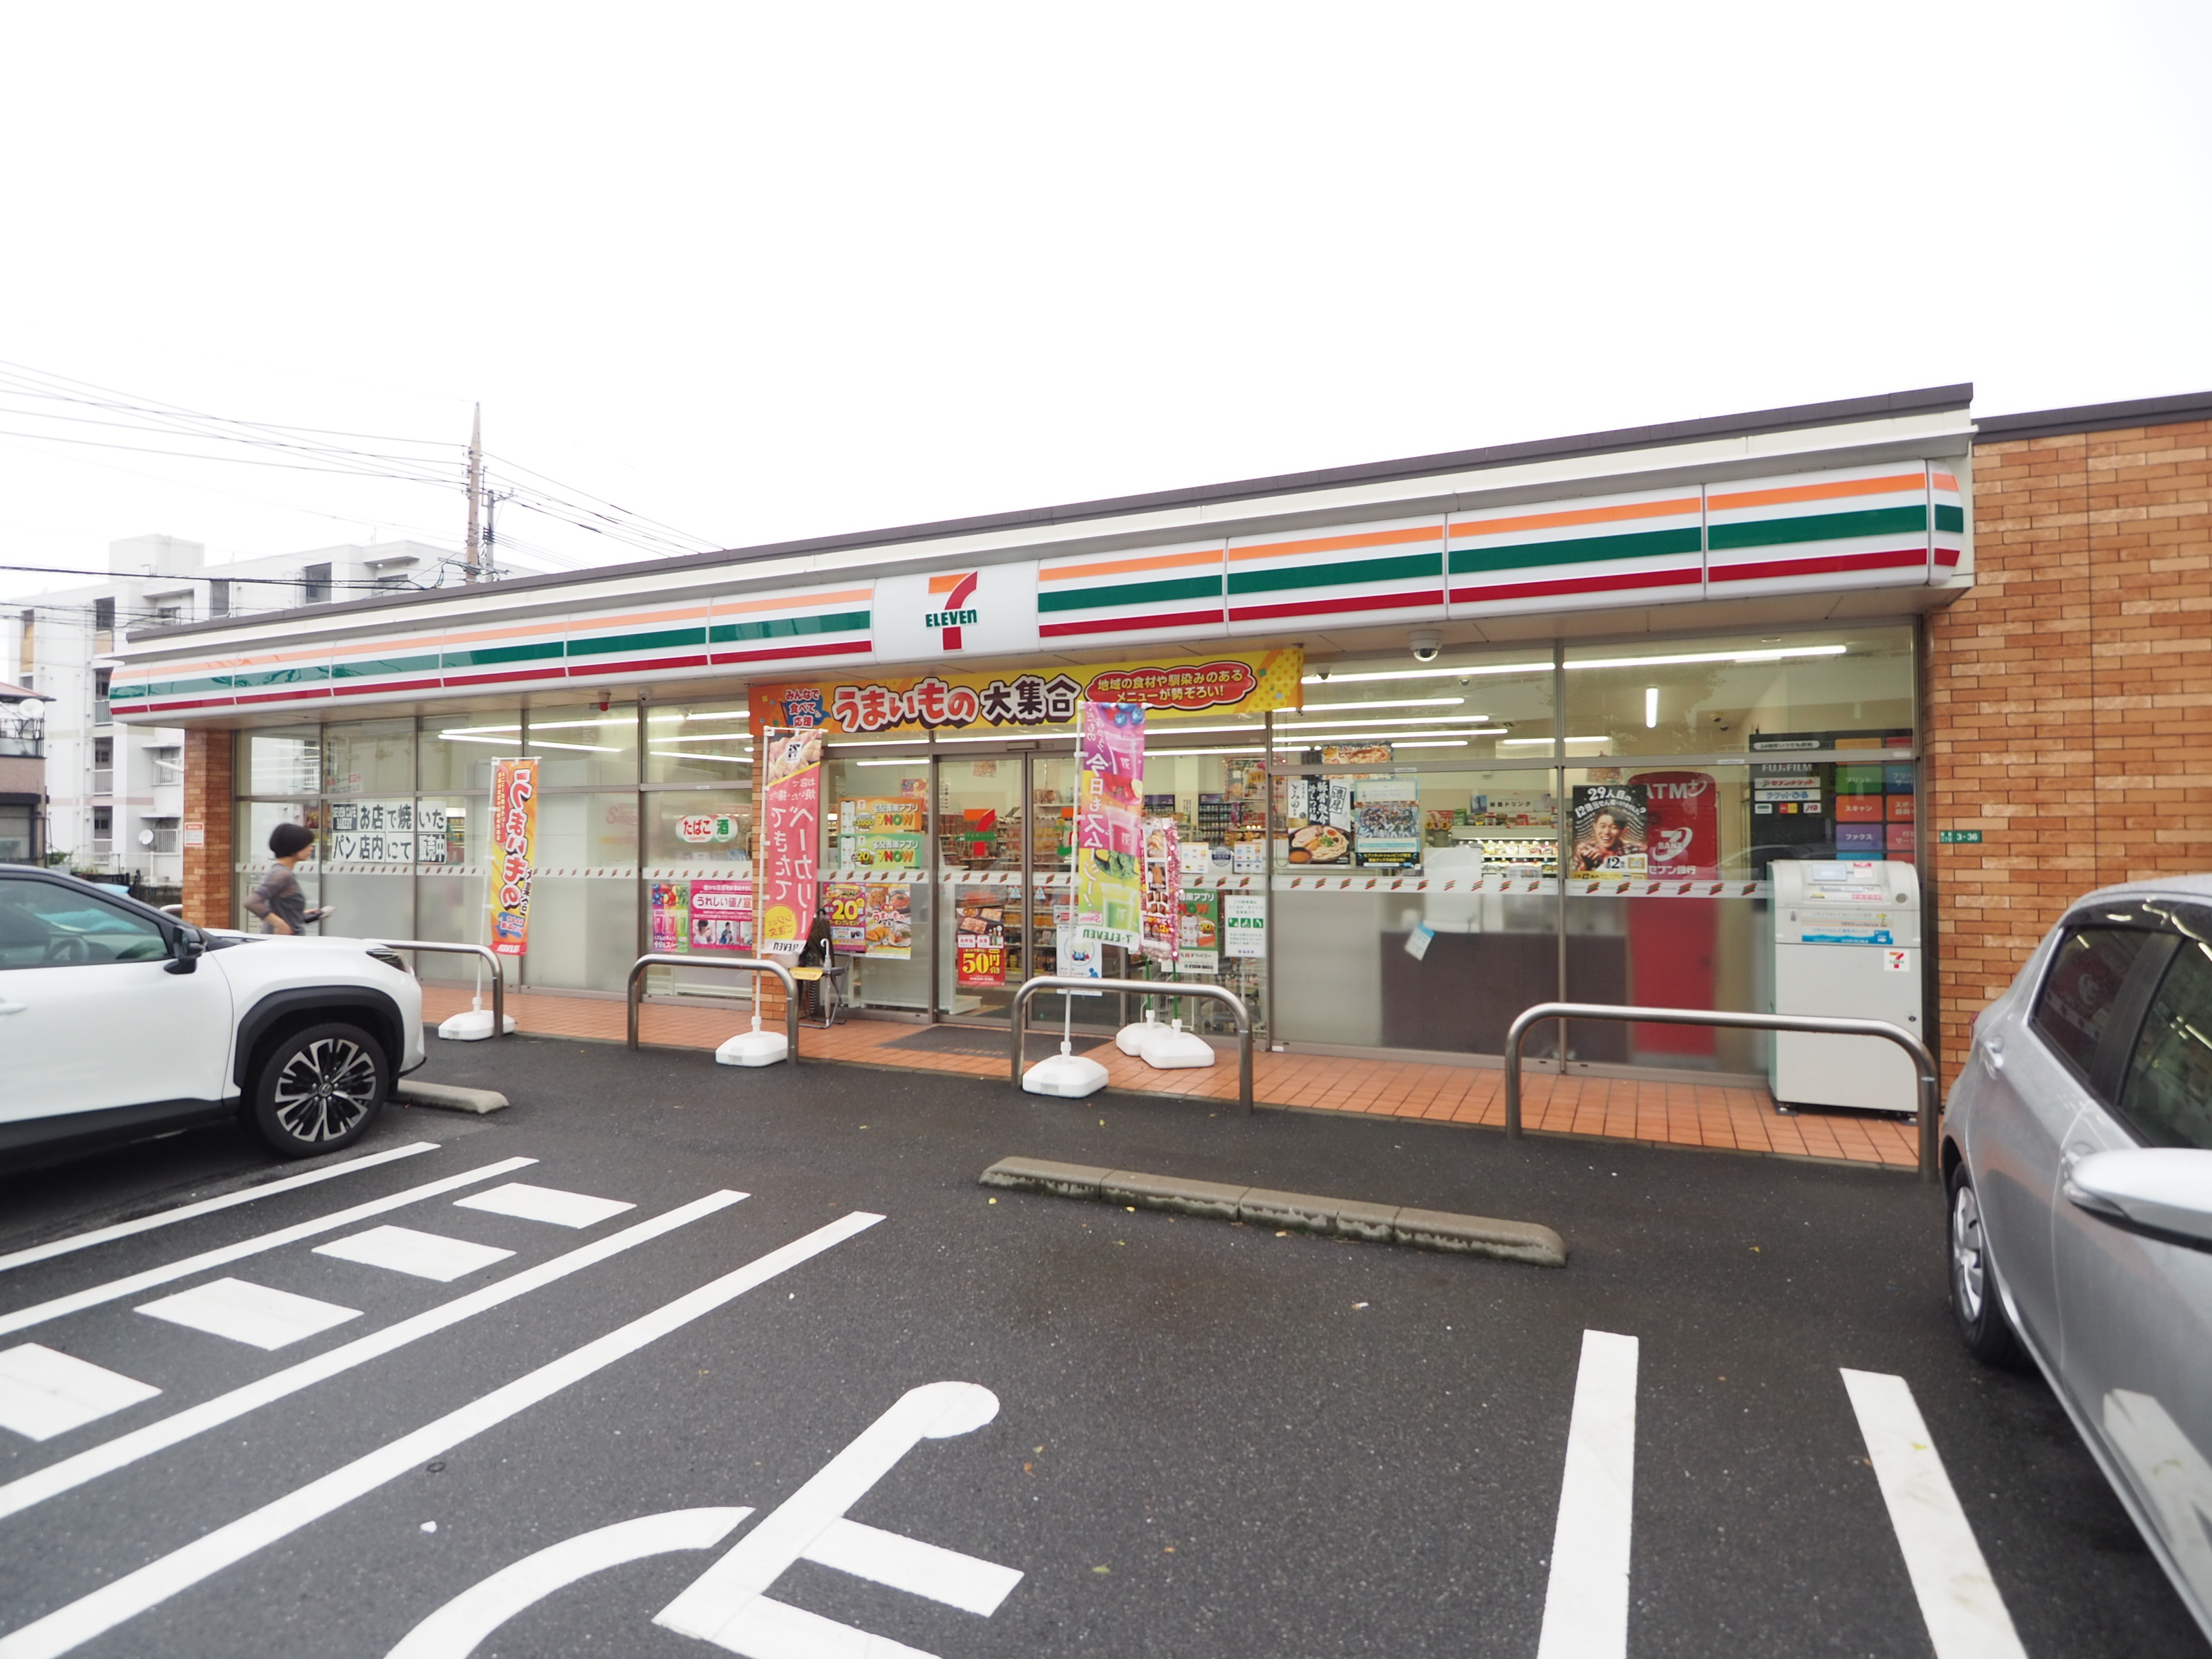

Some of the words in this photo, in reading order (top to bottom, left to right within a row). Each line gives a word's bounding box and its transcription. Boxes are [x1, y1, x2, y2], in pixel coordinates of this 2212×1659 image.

[1097, 669, 1244, 691] 地域の食材や馴染みのある
[785, 688, 821, 701] みんなで
[1116, 685, 1224, 702] メニューが勢ぞろい!
[789, 702, 816, 715] 食べて
[834, 679, 978, 731] うまいもの
[982, 675, 1082, 720] 大集合
[793, 715, 814, 729] 応援
[1587, 786, 1631, 802] 29人目の
[683, 820, 711, 835] たばこ
[717, 819, 729, 834] 酒
[877, 814, 914, 827] 7NOW
[1956, 832, 1978, 842] 3-36
[877, 850, 914, 863] 7NOW
[1648, 865, 1696, 875] セブン銀行
